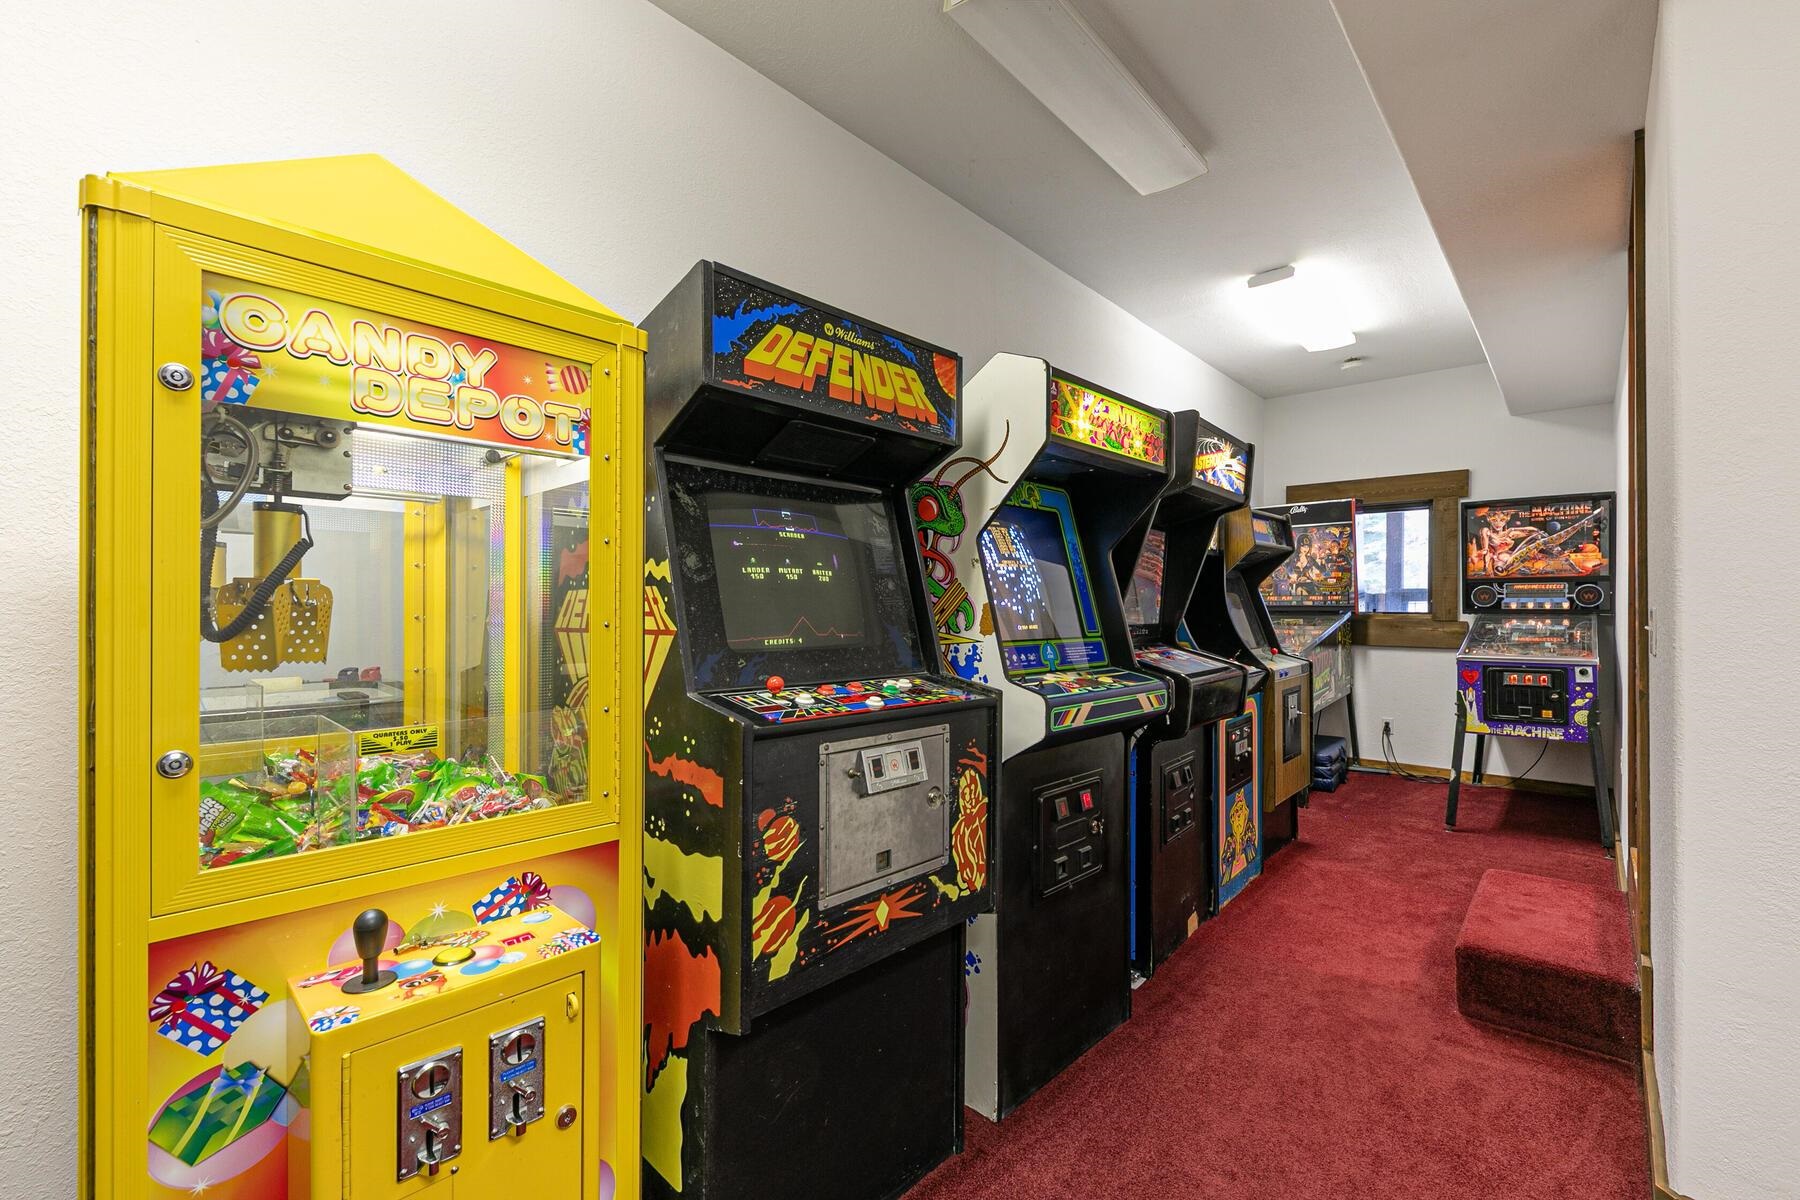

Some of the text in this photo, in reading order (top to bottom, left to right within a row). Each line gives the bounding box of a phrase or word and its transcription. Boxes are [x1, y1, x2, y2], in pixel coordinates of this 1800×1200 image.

[219, 293, 498, 388] CANDY
[833, 327, 875, 350] Williams
[744, 324, 938, 425] DEFENDER
[350, 365, 583, 445] DEPOT
[1531, 504, 1593, 517] MACHINE
[742, 566, 771, 574] LANDER
[373, 729, 408, 739] QUARTERS
[1502, 724, 1565, 740] MACHINE
